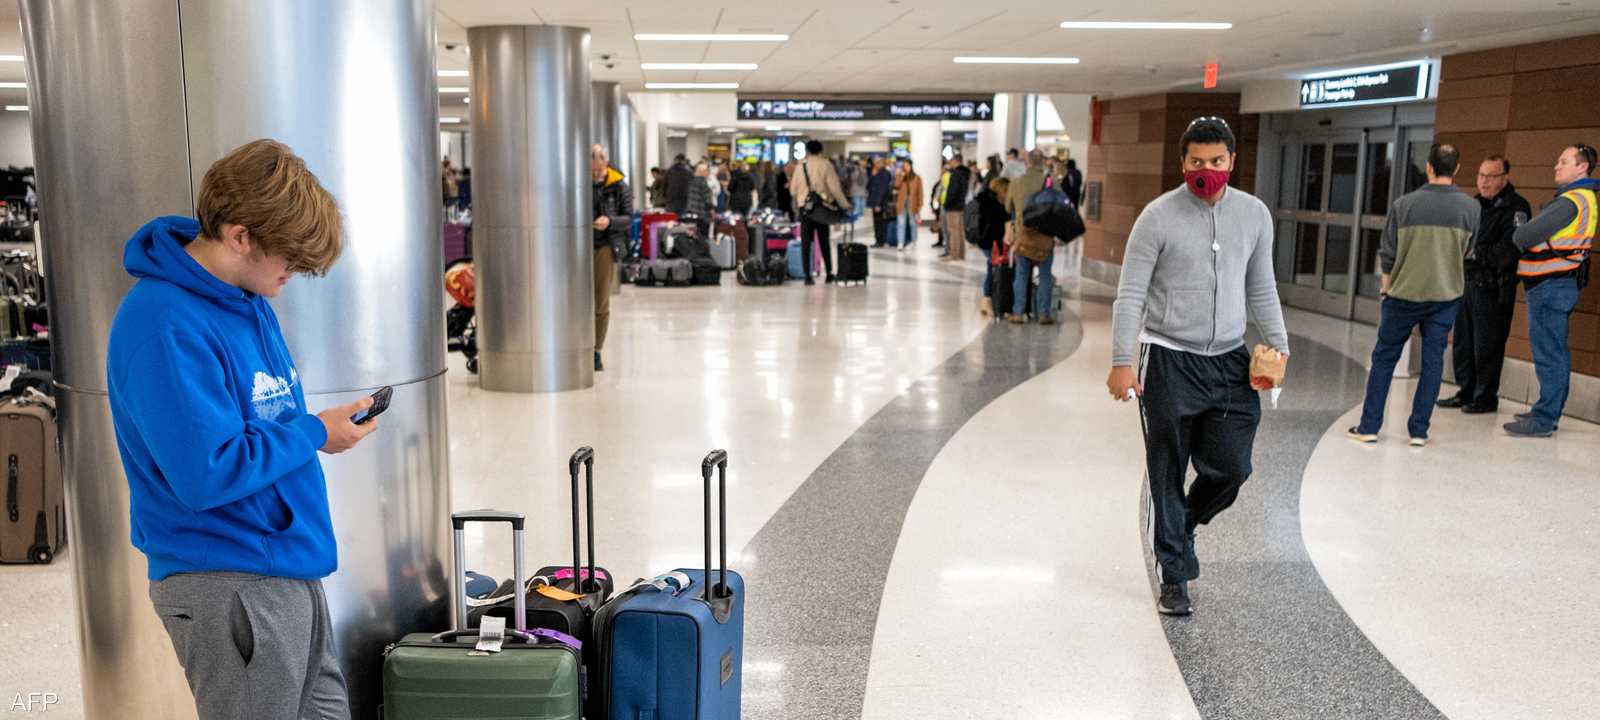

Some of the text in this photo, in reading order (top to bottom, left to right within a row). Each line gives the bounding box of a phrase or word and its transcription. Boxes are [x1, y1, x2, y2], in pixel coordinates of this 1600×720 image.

[811, 101, 824, 110] Car
[890, 104, 922, 116] Baggage
[922, 105, 943, 114] Claim
[788, 110, 864, 119] Ground Transportation
[794, 141, 806, 160] 3
